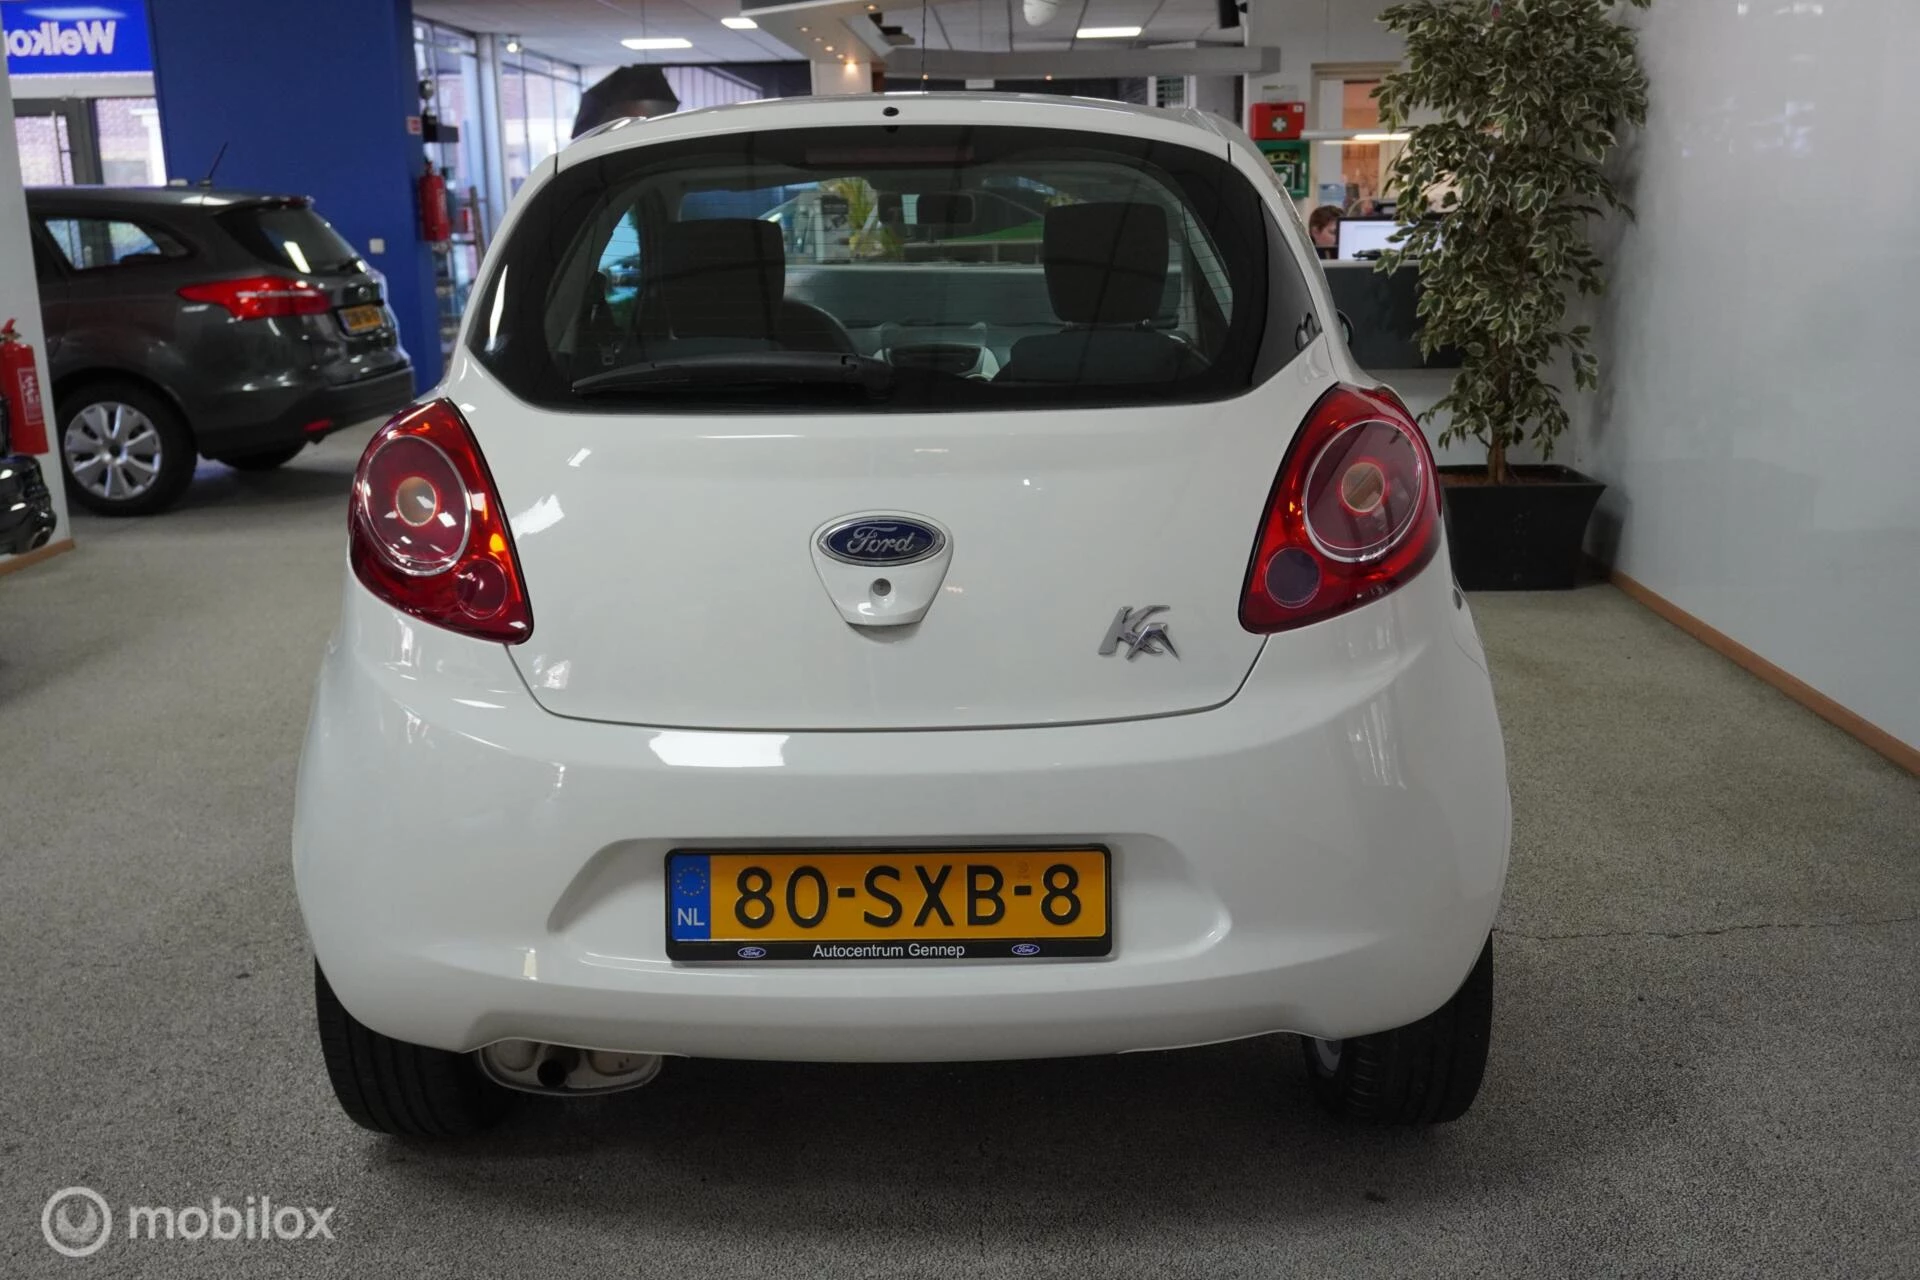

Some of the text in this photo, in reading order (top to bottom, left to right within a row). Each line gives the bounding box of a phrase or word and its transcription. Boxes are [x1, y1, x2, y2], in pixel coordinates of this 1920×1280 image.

[846, 526, 915, 554] Ford
[734, 864, 1081, 928] 80-SXB-8
[677, 907, 705, 926] NL
[812, 943, 965, 959] Autocentrum Gennep
